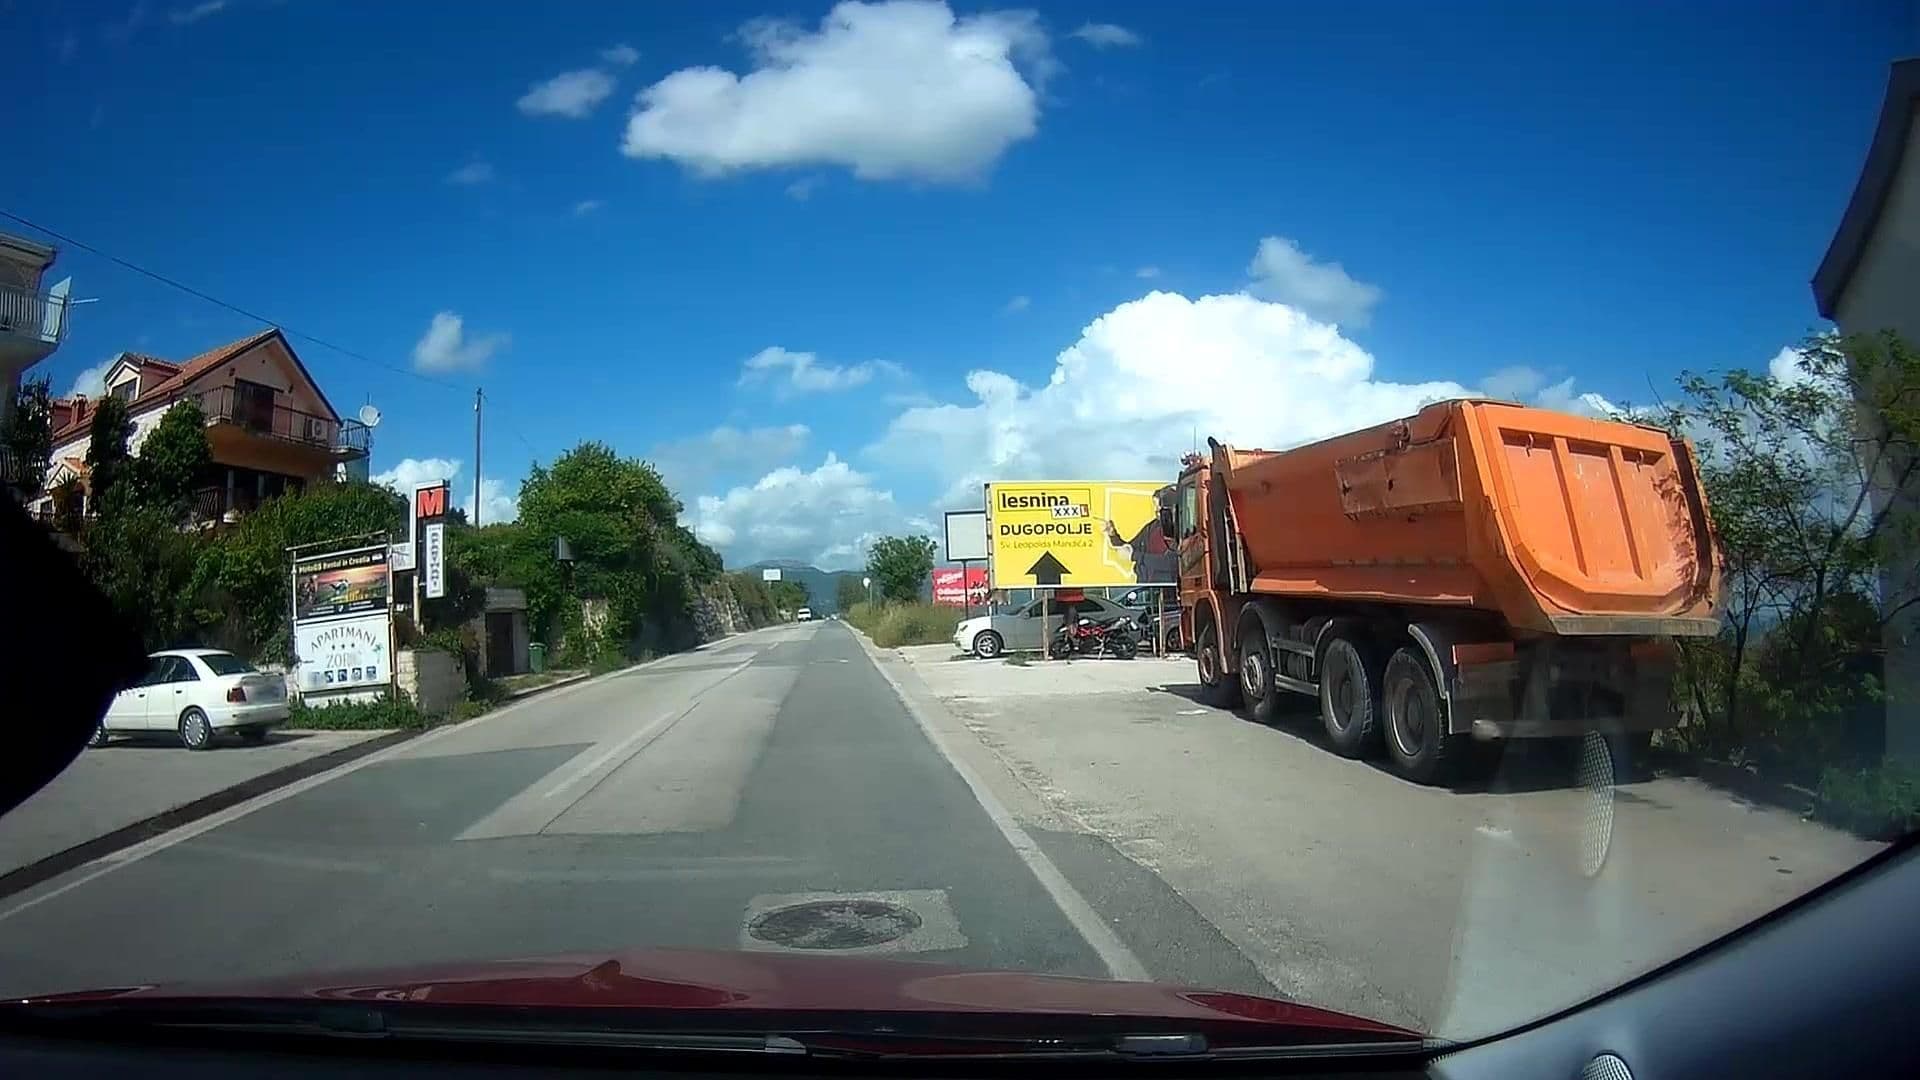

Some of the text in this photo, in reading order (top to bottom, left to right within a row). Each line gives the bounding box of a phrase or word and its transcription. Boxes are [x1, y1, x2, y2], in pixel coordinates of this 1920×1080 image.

[418, 488, 443, 517] M
[1002, 492, 1069, 508] lesnina
[1001, 523, 1092, 536] DUGOPOLJE
[311, 626, 376, 653] APARTMANI
